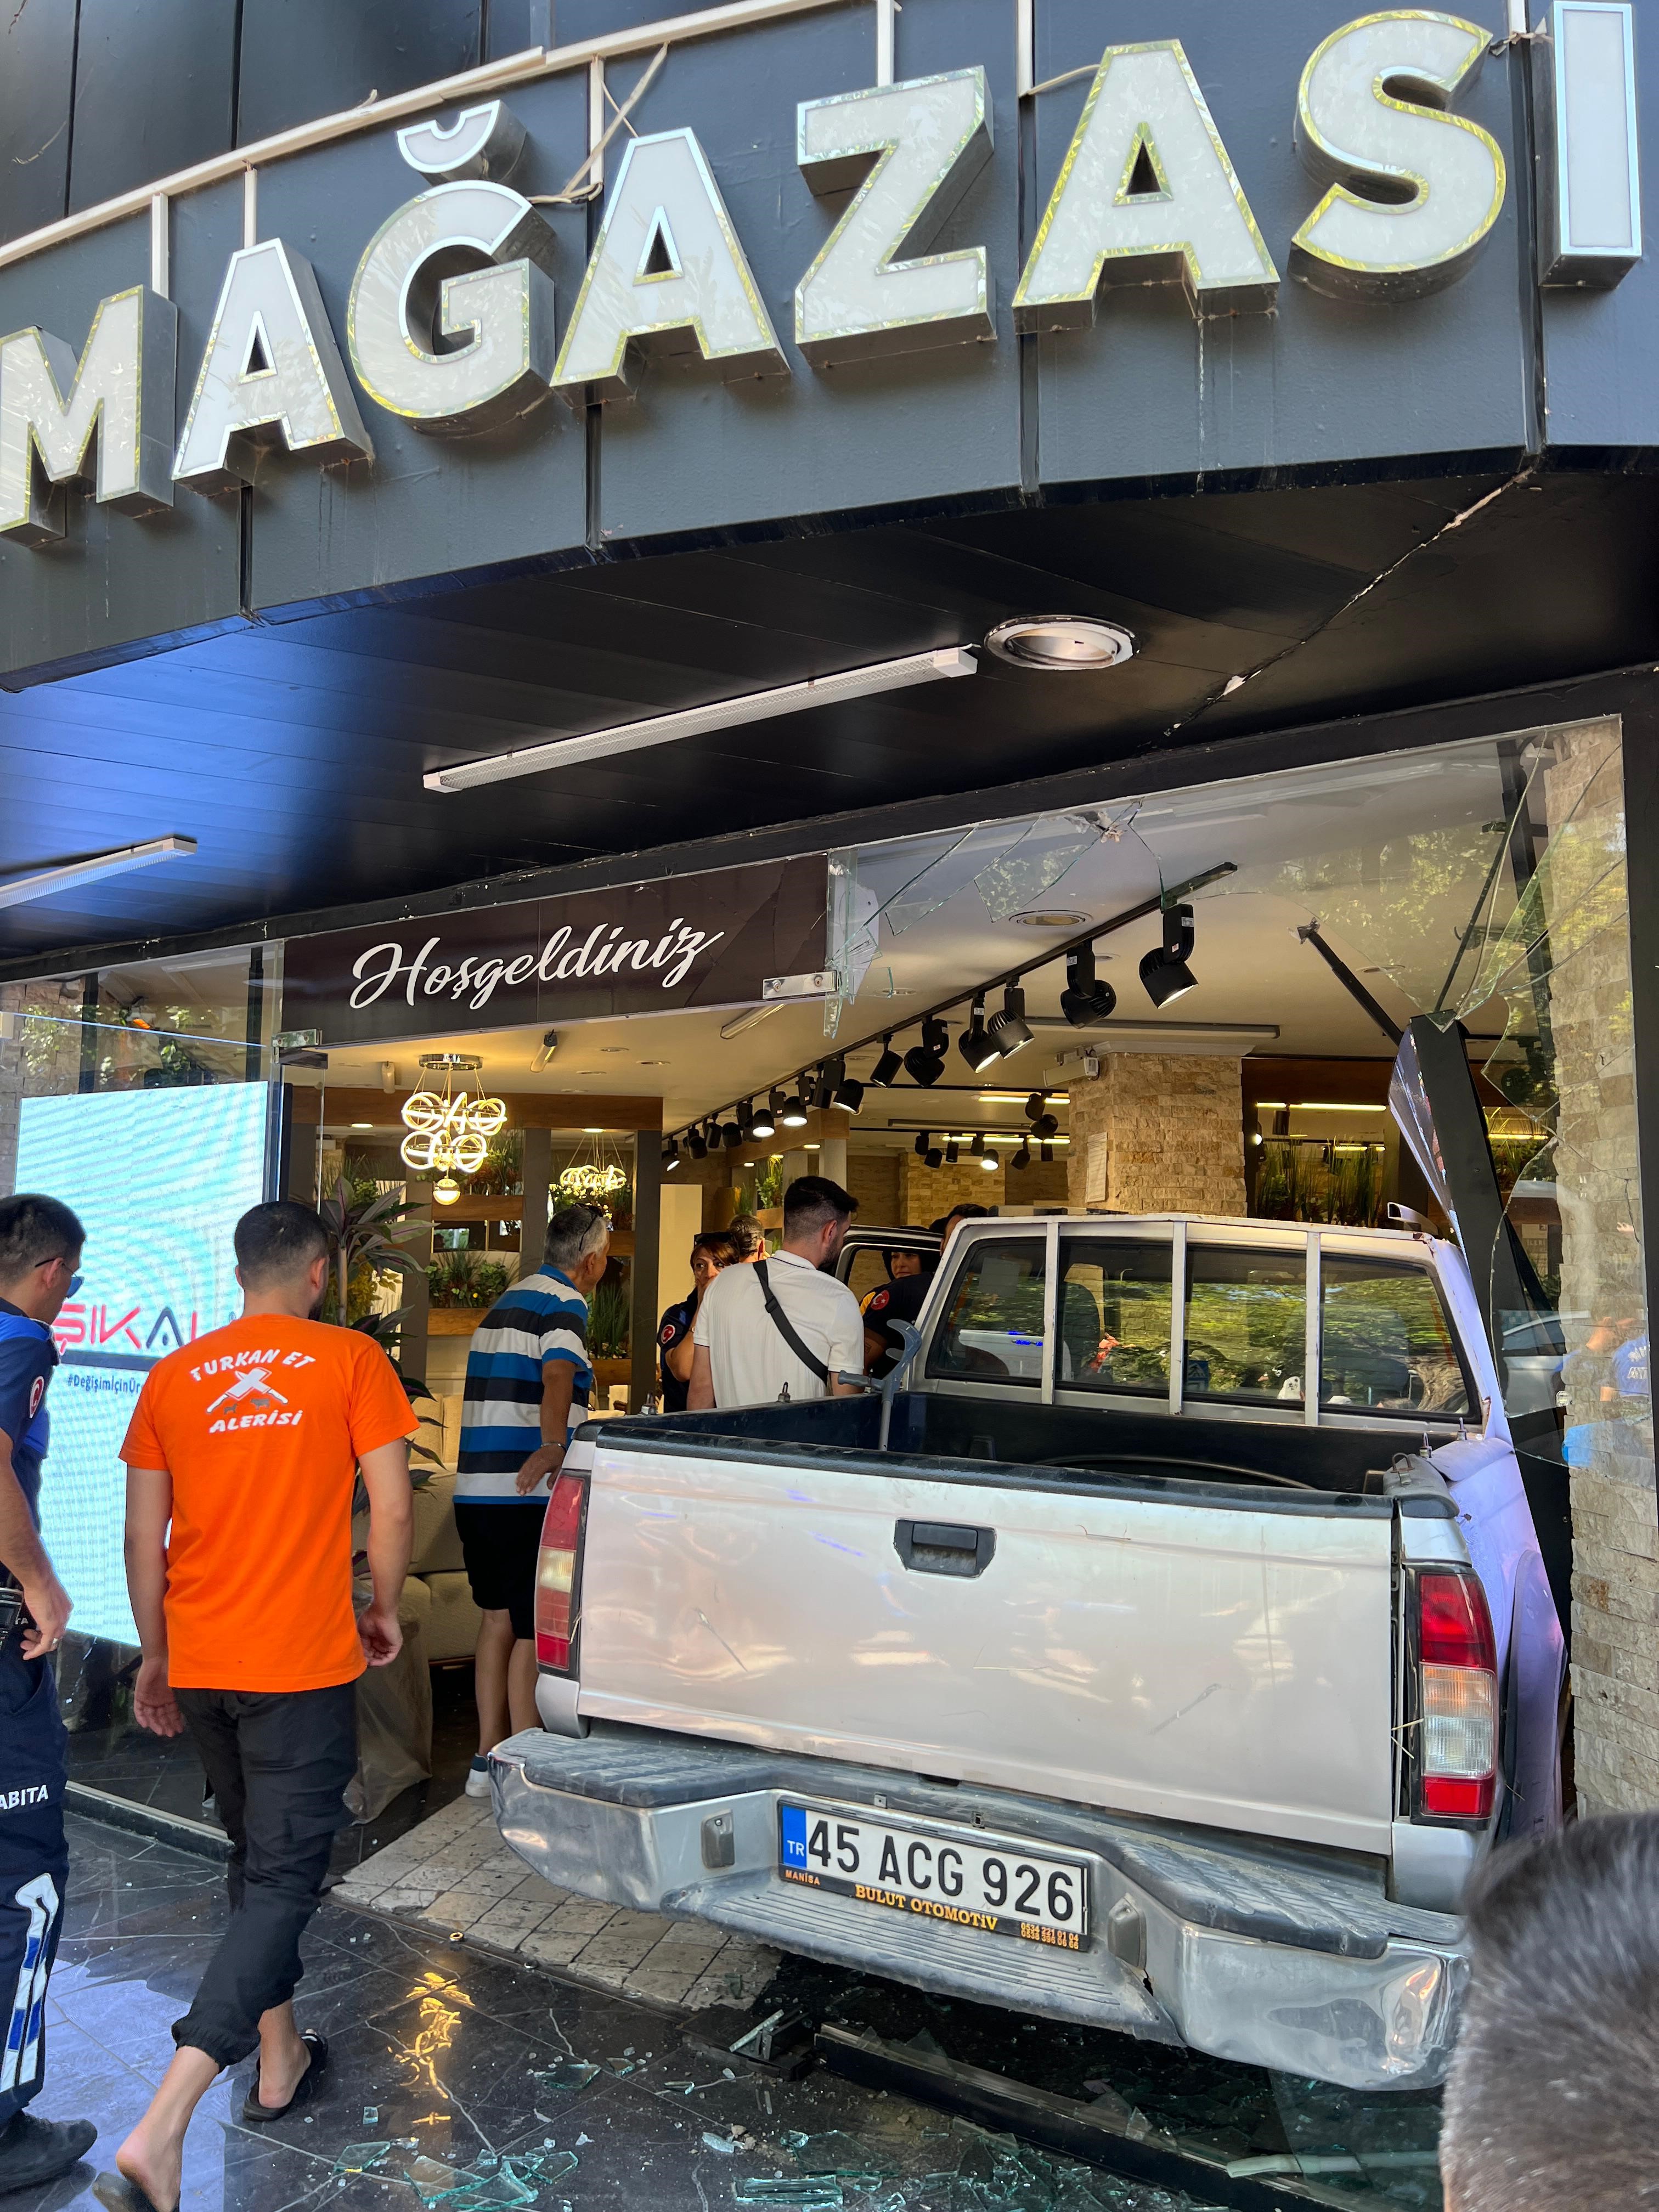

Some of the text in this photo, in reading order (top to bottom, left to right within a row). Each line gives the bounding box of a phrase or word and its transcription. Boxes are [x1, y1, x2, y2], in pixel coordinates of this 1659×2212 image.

[0, 1, 1643, 532] MAĞAZASI
[349, 918, 724, 1010] Hoşgeldiniz
[190, 1349, 317, 1381] TURKAN ET
[787, 1840, 804, 1857] TR
[809, 1820, 1073, 1921] 45 ACG 926
[855, 1884, 906, 1908] BULUT
[1057, 1931, 1066, 1940] 01
[1069, 1933, 1079, 1942] 04
